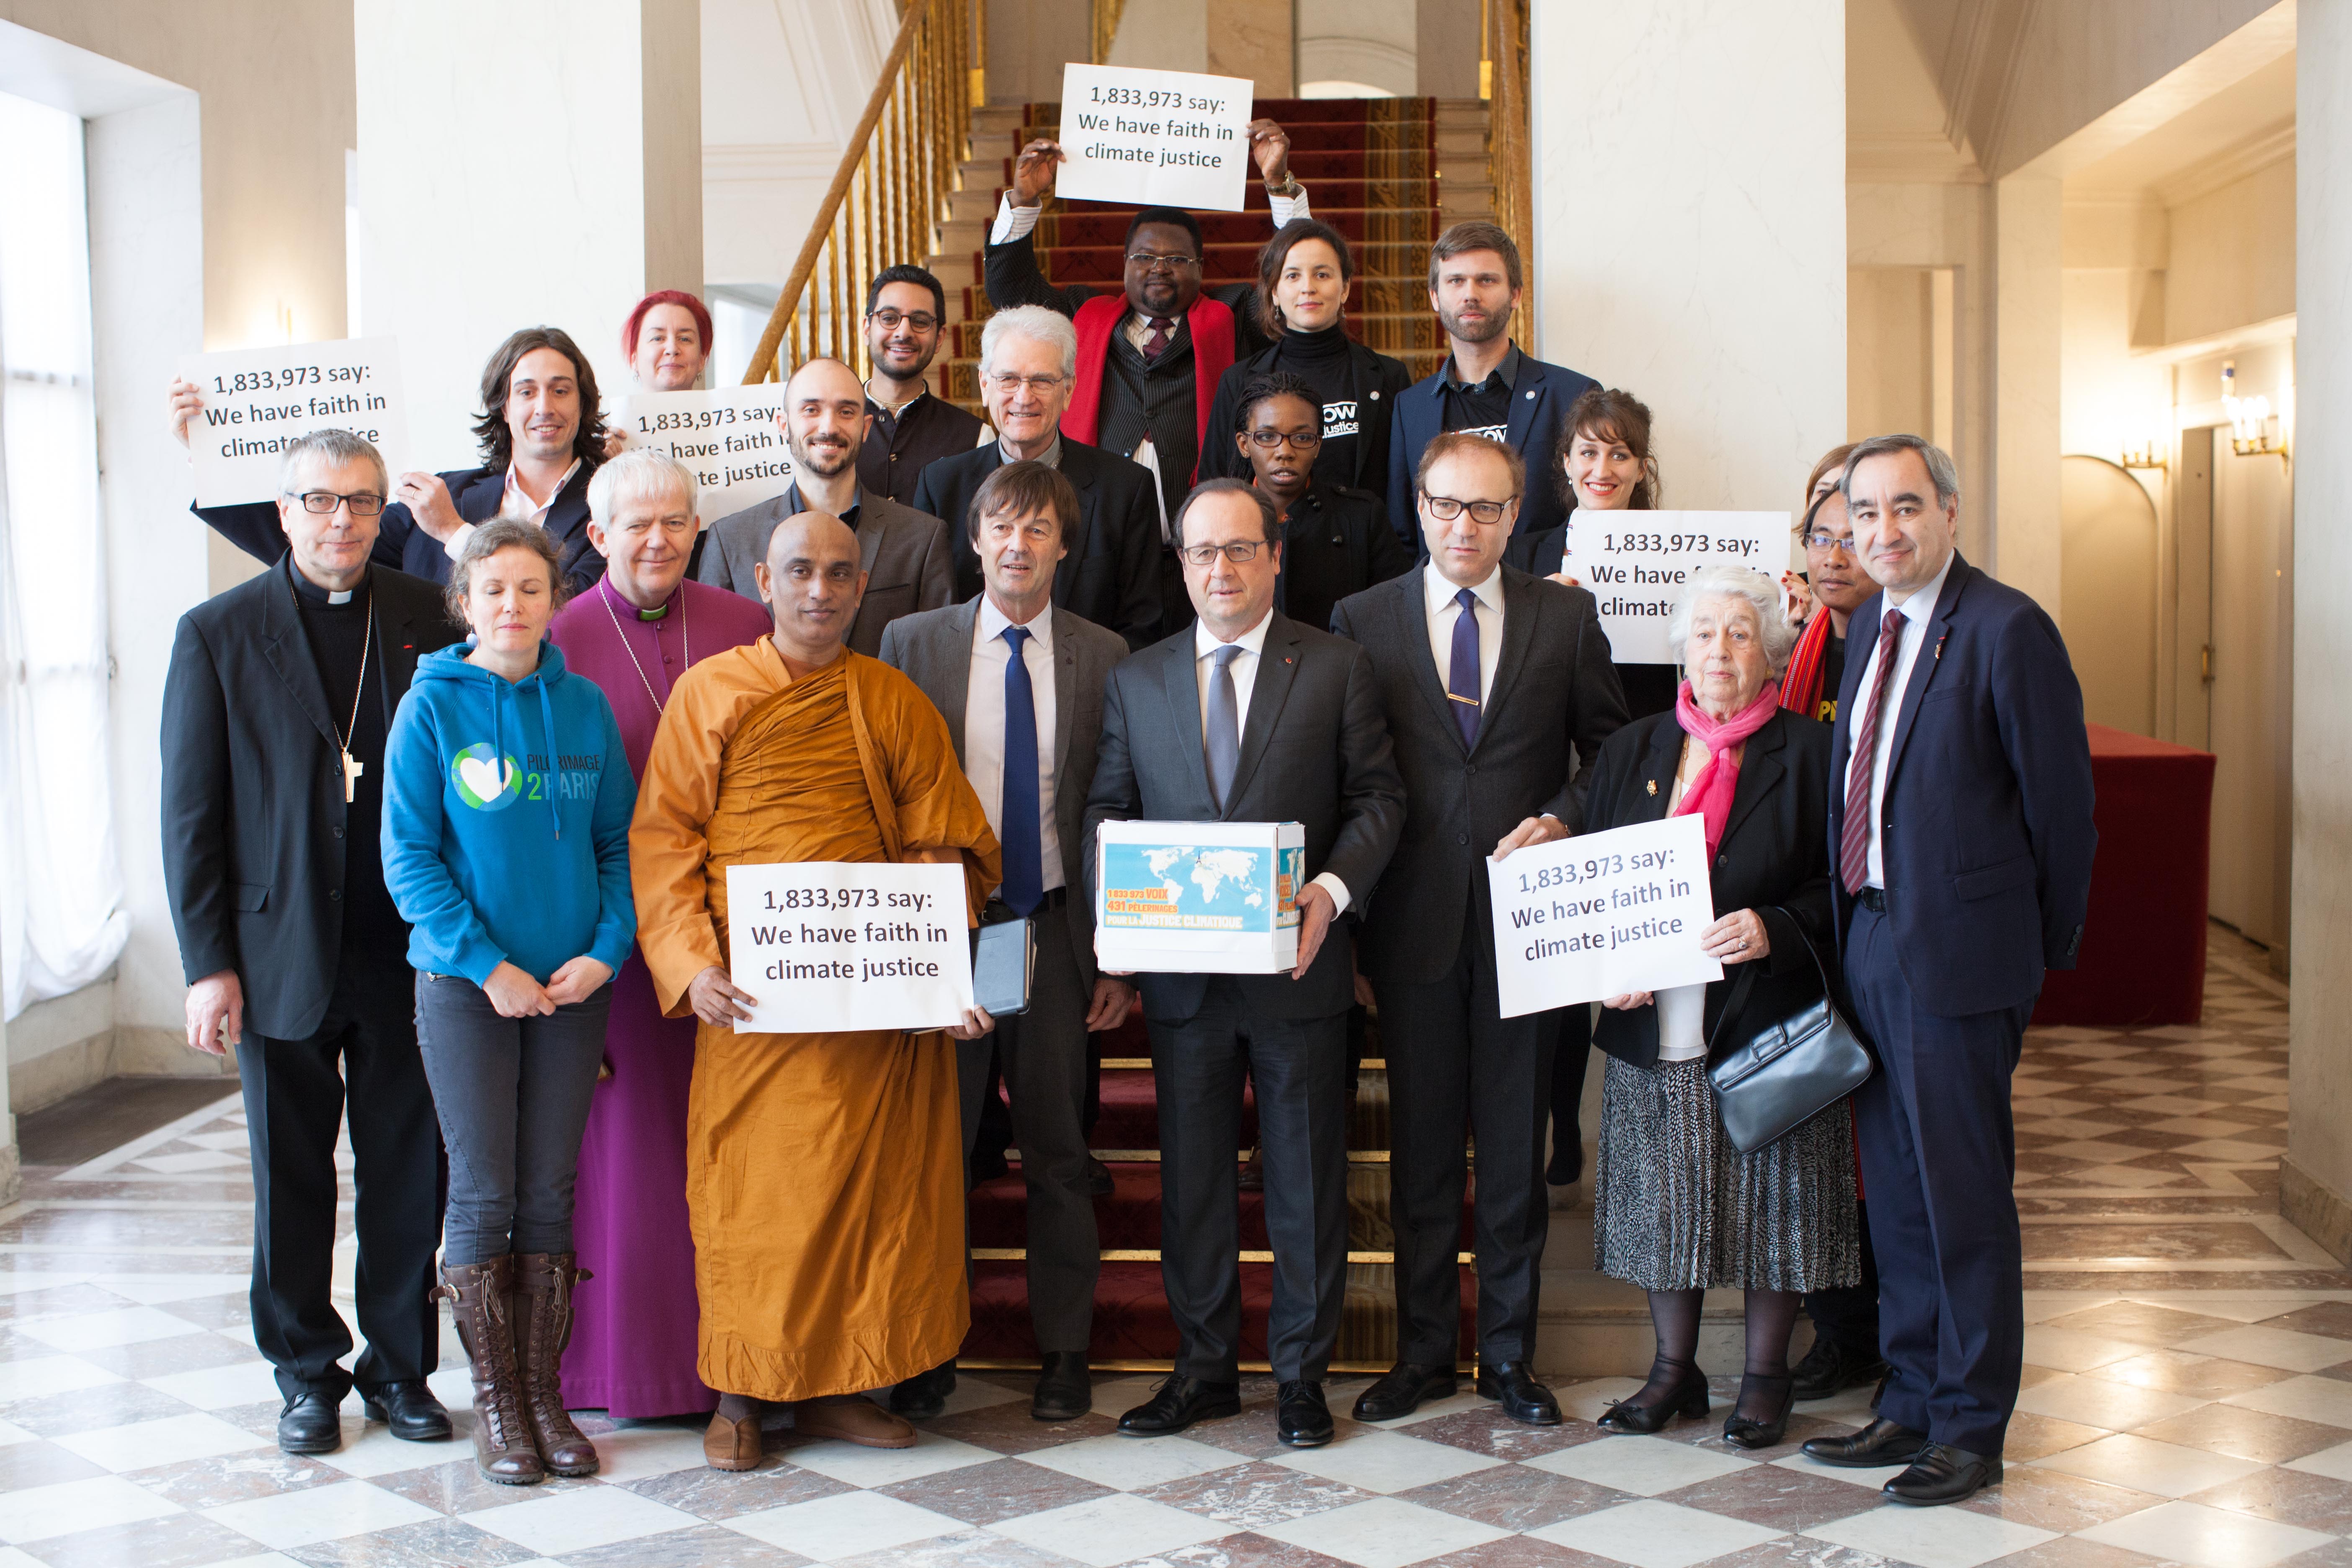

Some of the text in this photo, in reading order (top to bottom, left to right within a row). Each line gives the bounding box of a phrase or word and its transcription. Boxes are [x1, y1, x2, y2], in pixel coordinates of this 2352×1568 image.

[1091, 86, 1225, 115] 1,833,973 say:
[1078, 114, 1233, 140] We have faith in
[1085, 142, 1222, 168] climate justice
[214, 366, 371, 396] 1,833,973 say:
[205, 392, 386, 426] We have faith in
[639, 408, 736, 435] 1,833,973
[1323, 405, 1356, 423] OW
[671, 431, 789, 459] have faith i
[725, 461, 791, 487] justice
[1604, 534, 1759, 557] 1,833,973 say:
[1591, 565, 1627, 583] We
[1634, 565, 1686, 584] have
[1519, 849, 1675, 894] 1,833,973 say:
[763, 888, 932, 913] 1,833,973 say:
[1107, 900, 1126, 911] 431
[1145, 888, 1168, 899] VOIX
[1511, 878, 1690, 929] We have faith in
[751, 921, 948, 945] We have faith in
[1107, 915, 1243, 928] POUR LA JUSTICE CLIMATIQUE
[1525, 917, 1683, 962] climate justice
[766, 957, 939, 983] climate justice
